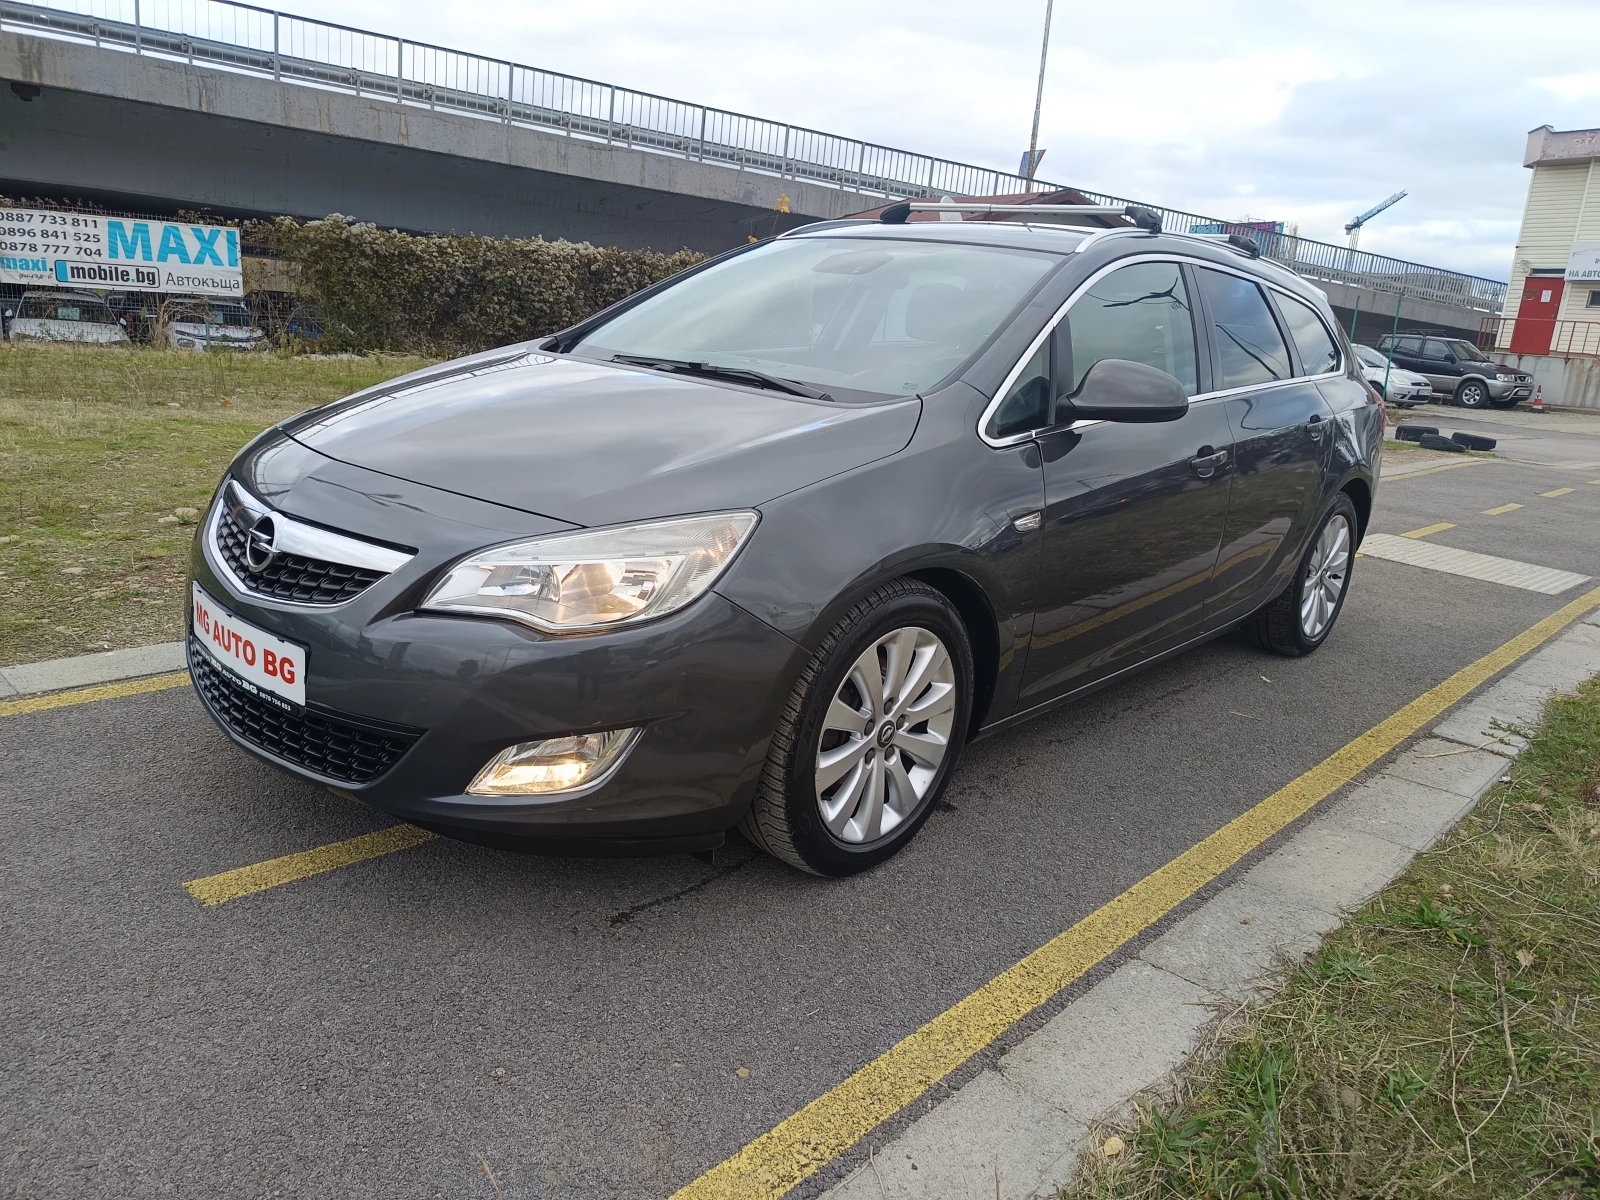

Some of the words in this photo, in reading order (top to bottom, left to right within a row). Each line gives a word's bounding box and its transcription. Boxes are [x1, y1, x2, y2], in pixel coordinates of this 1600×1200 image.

[39, 214, 67, 226] 733
[71, 217, 98, 229] 811
[0, 226, 36, 238] 0896
[40, 229, 67, 240] 841
[73, 232, 101, 243] 525
[107, 219, 239, 268] MAXI
[0, 241, 38, 253] 0878
[41, 244, 70, 255] 777
[74, 246, 102, 258] 704
[70, 264, 156, 286] mobile.bg
[165, 272, 241, 292] Автокъща
[1568, 270, 1579, 278] НА
[196, 600, 210, 635] MG
[213, 619, 257, 667] AUTO
[263, 648, 296, 685] BG
[222, 669, 242, 685] AUTO
[242, 679, 258, 695] BG
